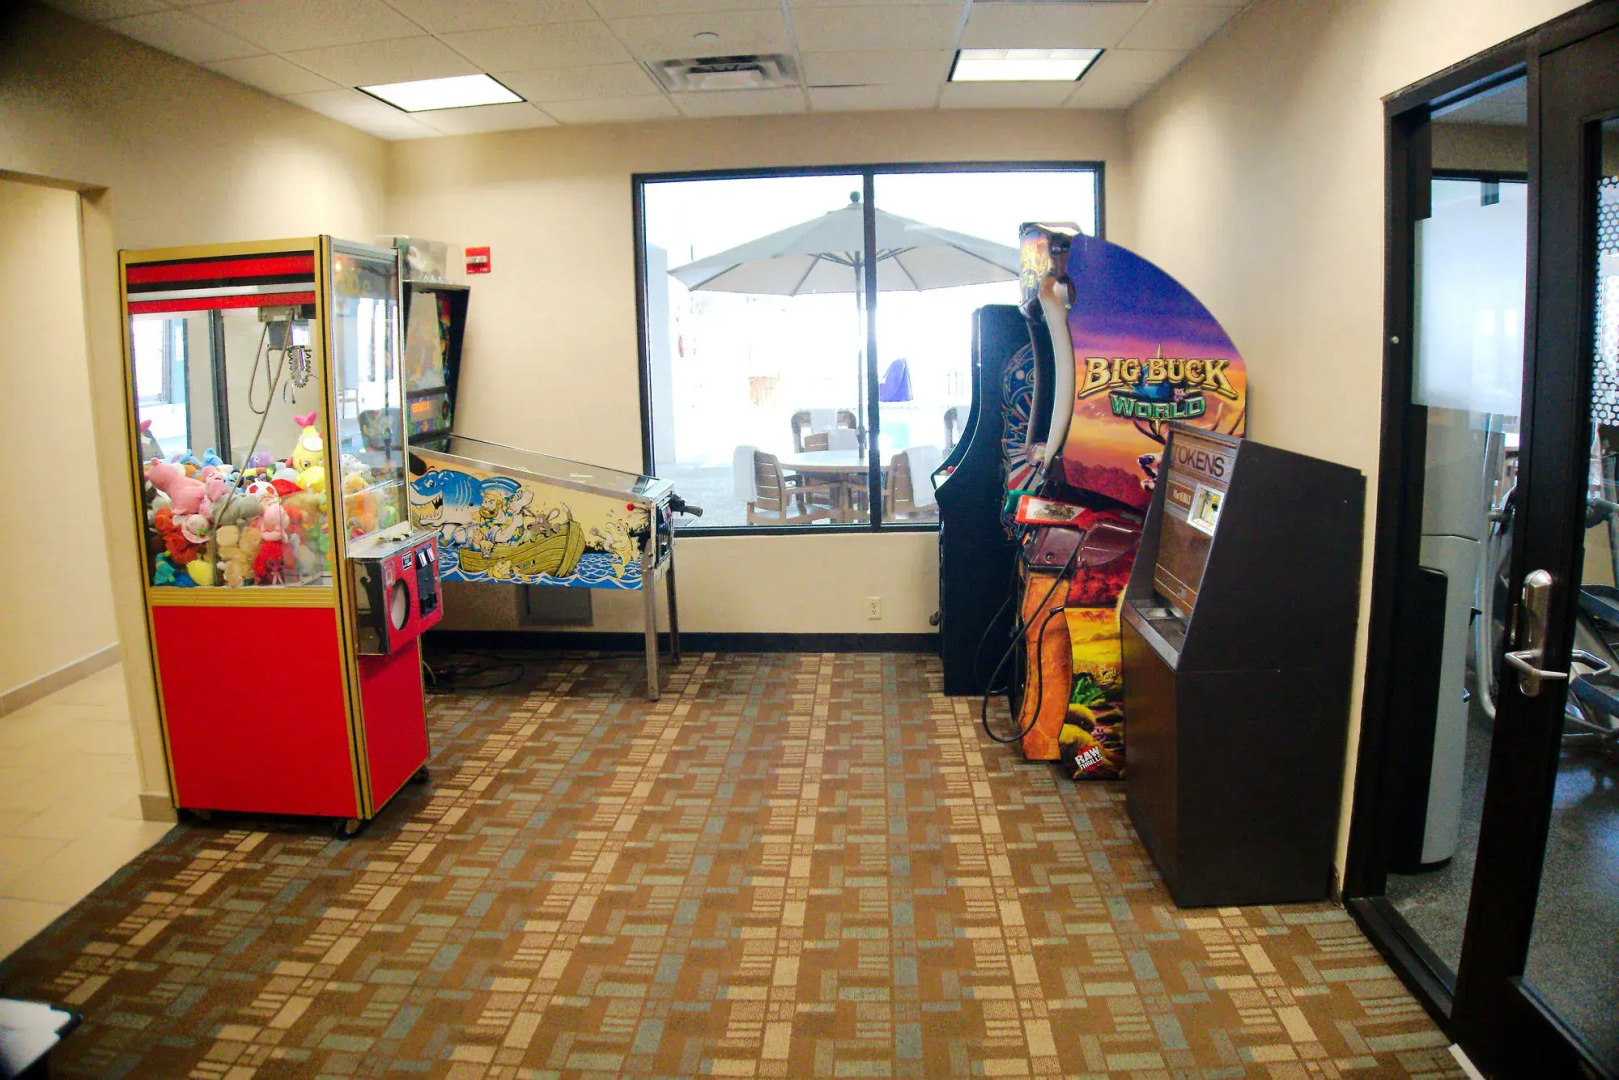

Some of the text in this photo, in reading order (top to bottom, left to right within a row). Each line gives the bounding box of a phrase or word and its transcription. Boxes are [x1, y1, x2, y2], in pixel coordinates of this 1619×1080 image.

[1078, 357, 1238, 400] BIG BUCK
[1109, 394, 1206, 419] WORLD
[1173, 443, 1225, 478] TOKENS
[1074, 746, 1101, 766] RAW
